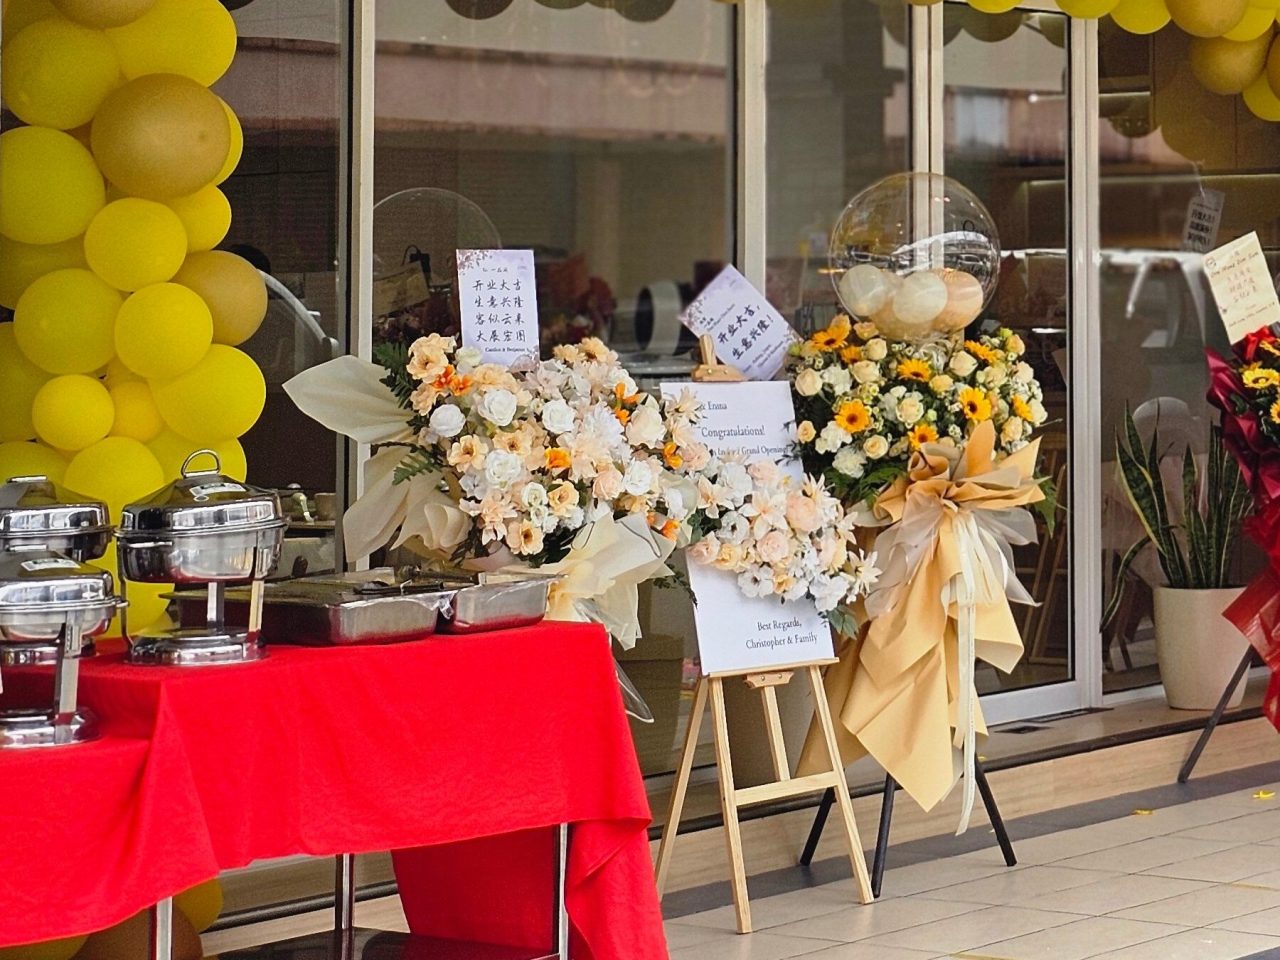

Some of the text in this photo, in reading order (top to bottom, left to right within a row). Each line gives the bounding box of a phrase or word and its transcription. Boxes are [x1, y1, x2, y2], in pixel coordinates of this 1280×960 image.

[472, 279, 522, 291] 开业大吉
[474, 296, 524, 308] 生意兴隆
[701, 425, 765, 441] Congratulations!
[741, 446, 760, 456] Grand
[757, 617, 802, 632] Best Regards,
[746, 631, 818, 650] Christopher & Family
